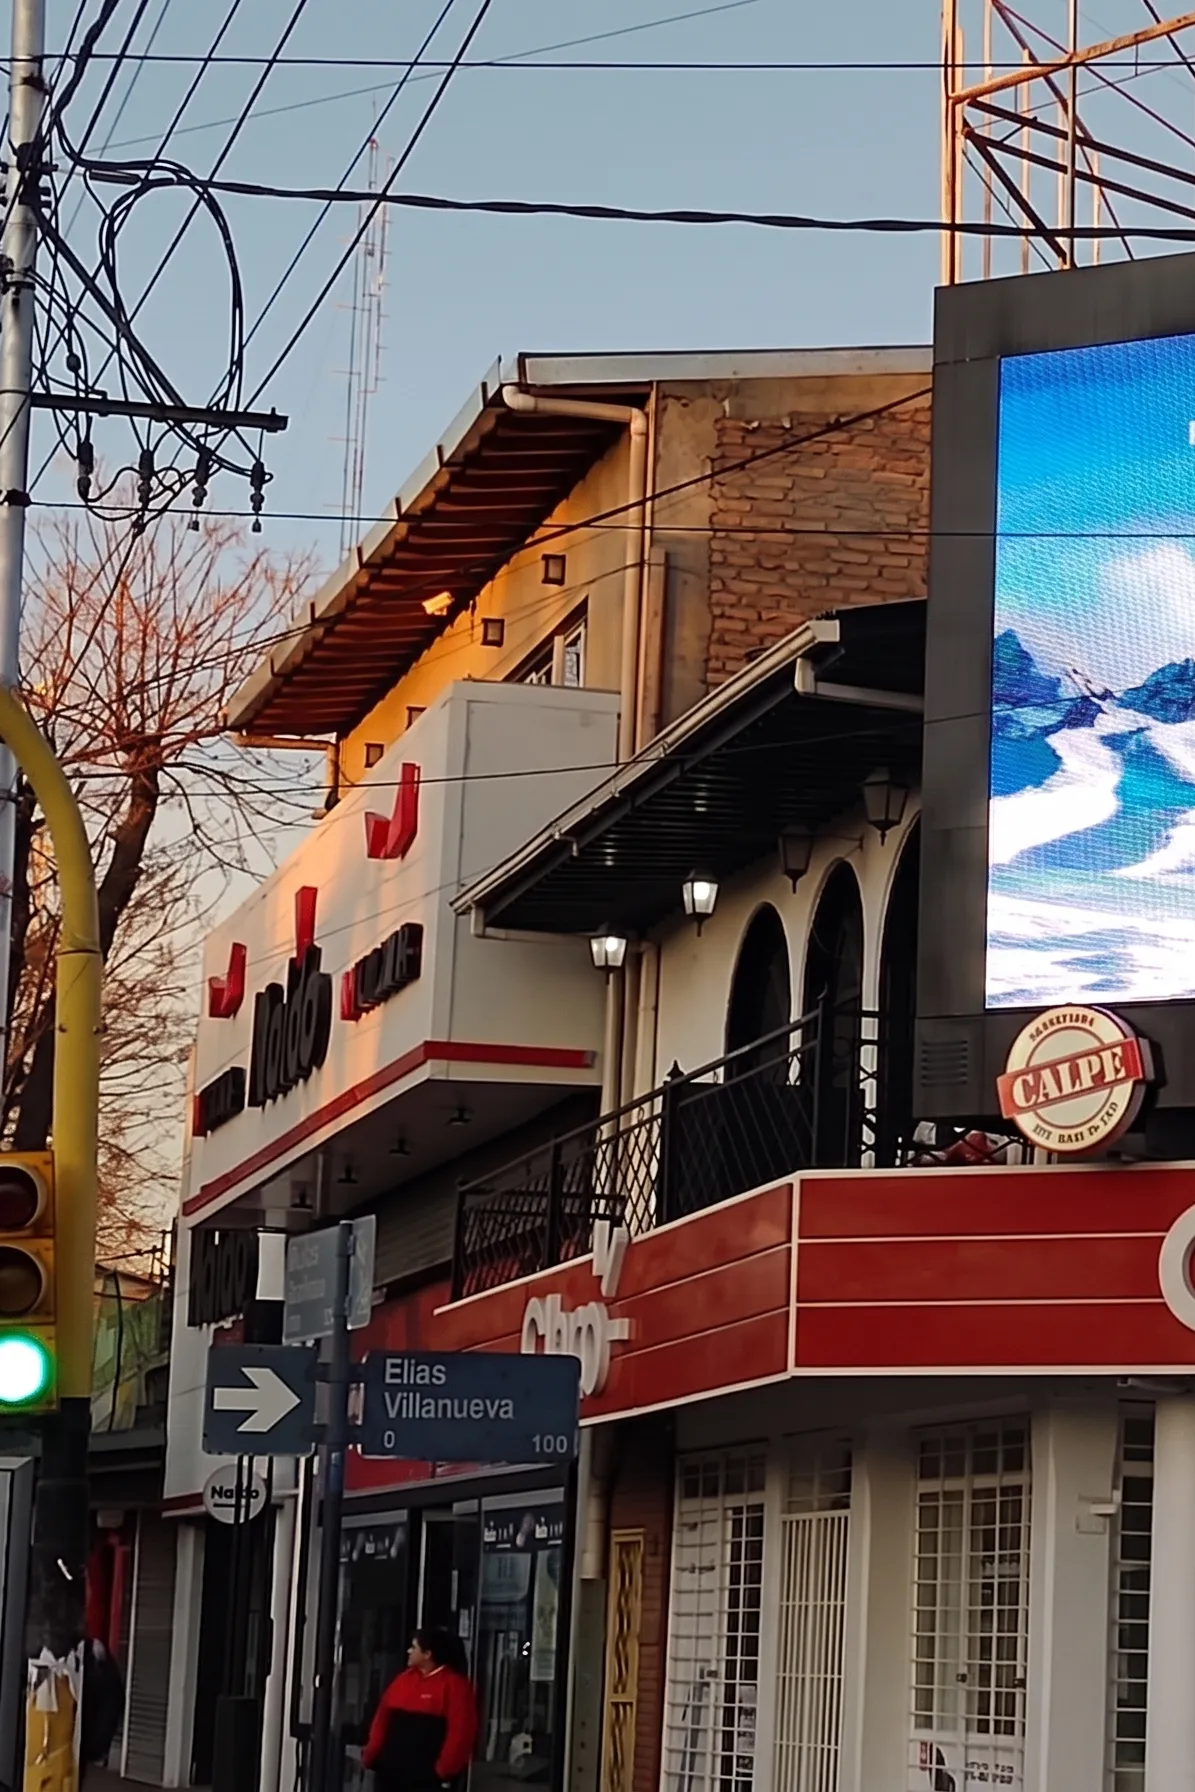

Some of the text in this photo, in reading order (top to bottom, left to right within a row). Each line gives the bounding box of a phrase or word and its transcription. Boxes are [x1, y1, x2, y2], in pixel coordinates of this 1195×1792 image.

[1012, 1047, 1127, 1108] CALPE
[384, 1358, 447, 1385] Elias
[384, 1392, 514, 1419] Villanueva
[383, 1430, 568, 1453] 0 100
